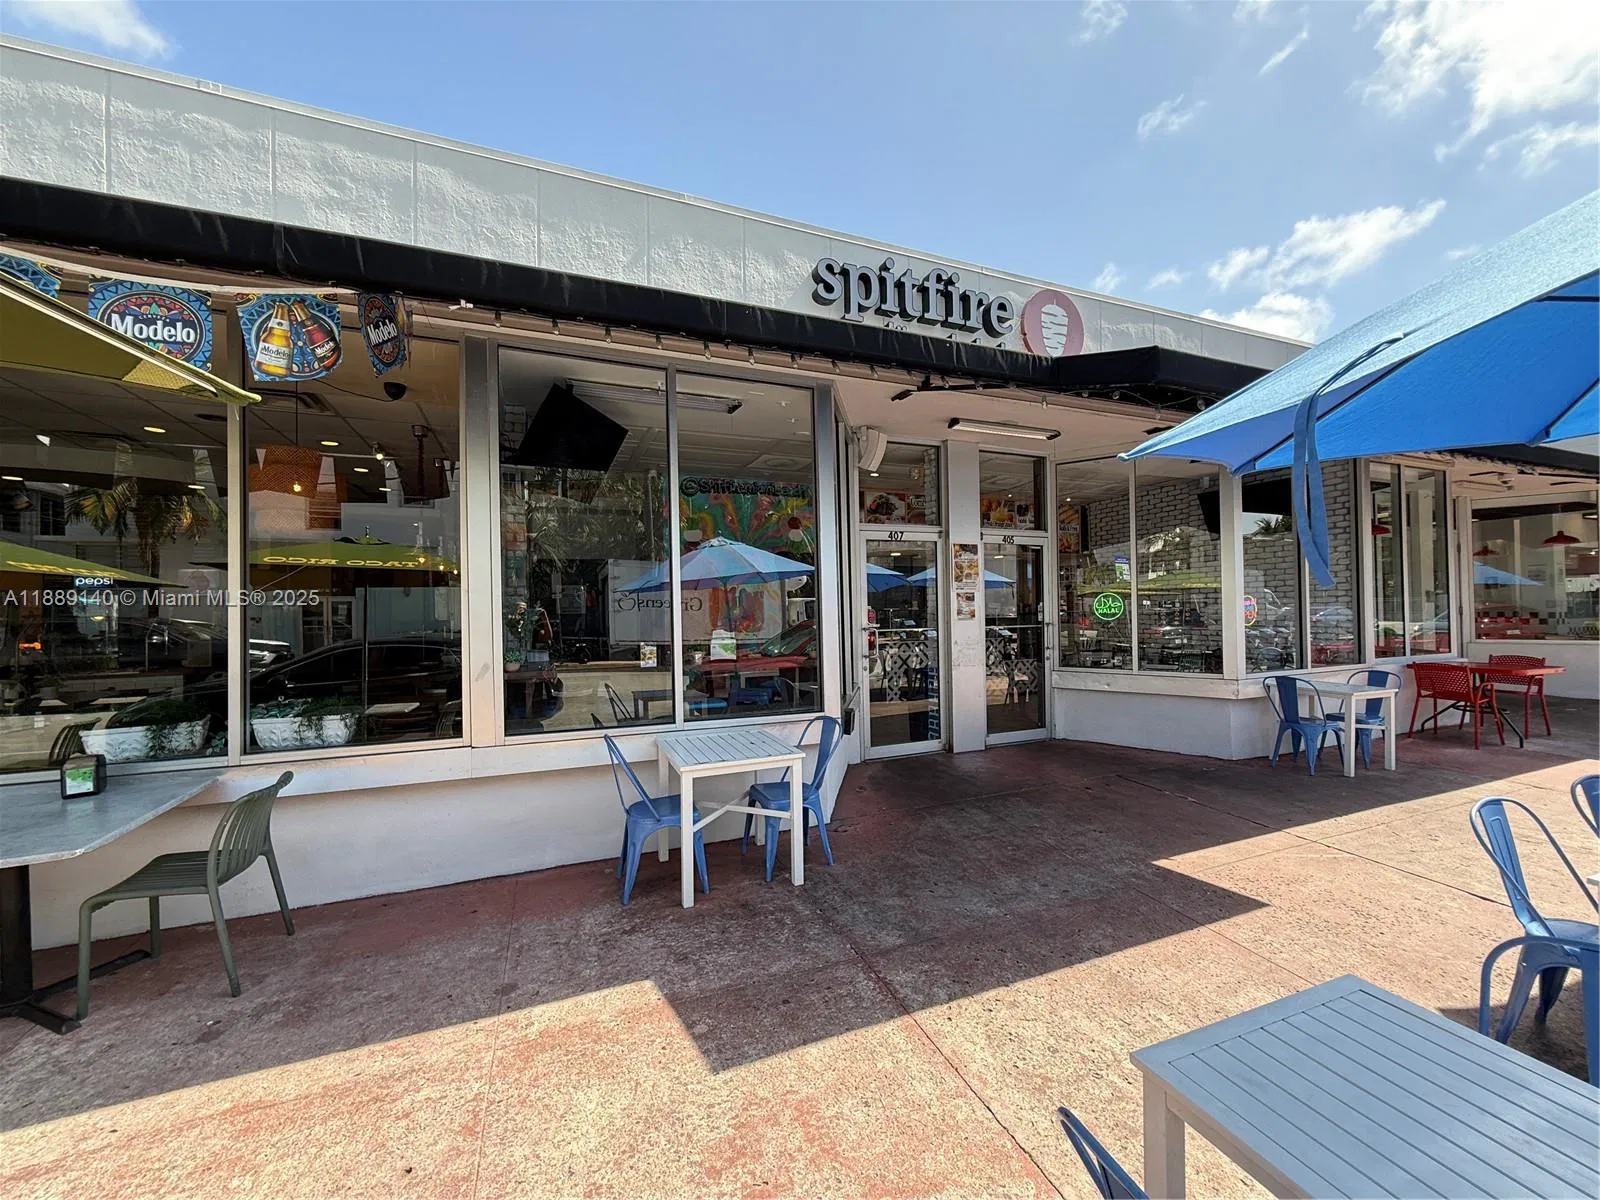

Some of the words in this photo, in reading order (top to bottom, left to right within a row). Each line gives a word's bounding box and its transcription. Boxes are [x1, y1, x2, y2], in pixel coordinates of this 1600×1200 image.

[812, 257, 1015, 338] spitfire
[111, 313, 195, 343] Modelo
[367, 319, 398, 346] Modelo
[888, 531, 904, 541] 407
[1002, 536, 1015, 545] 405
[75, 576, 114, 587] pepsi
[1096, 597, 1121, 609] حلال
